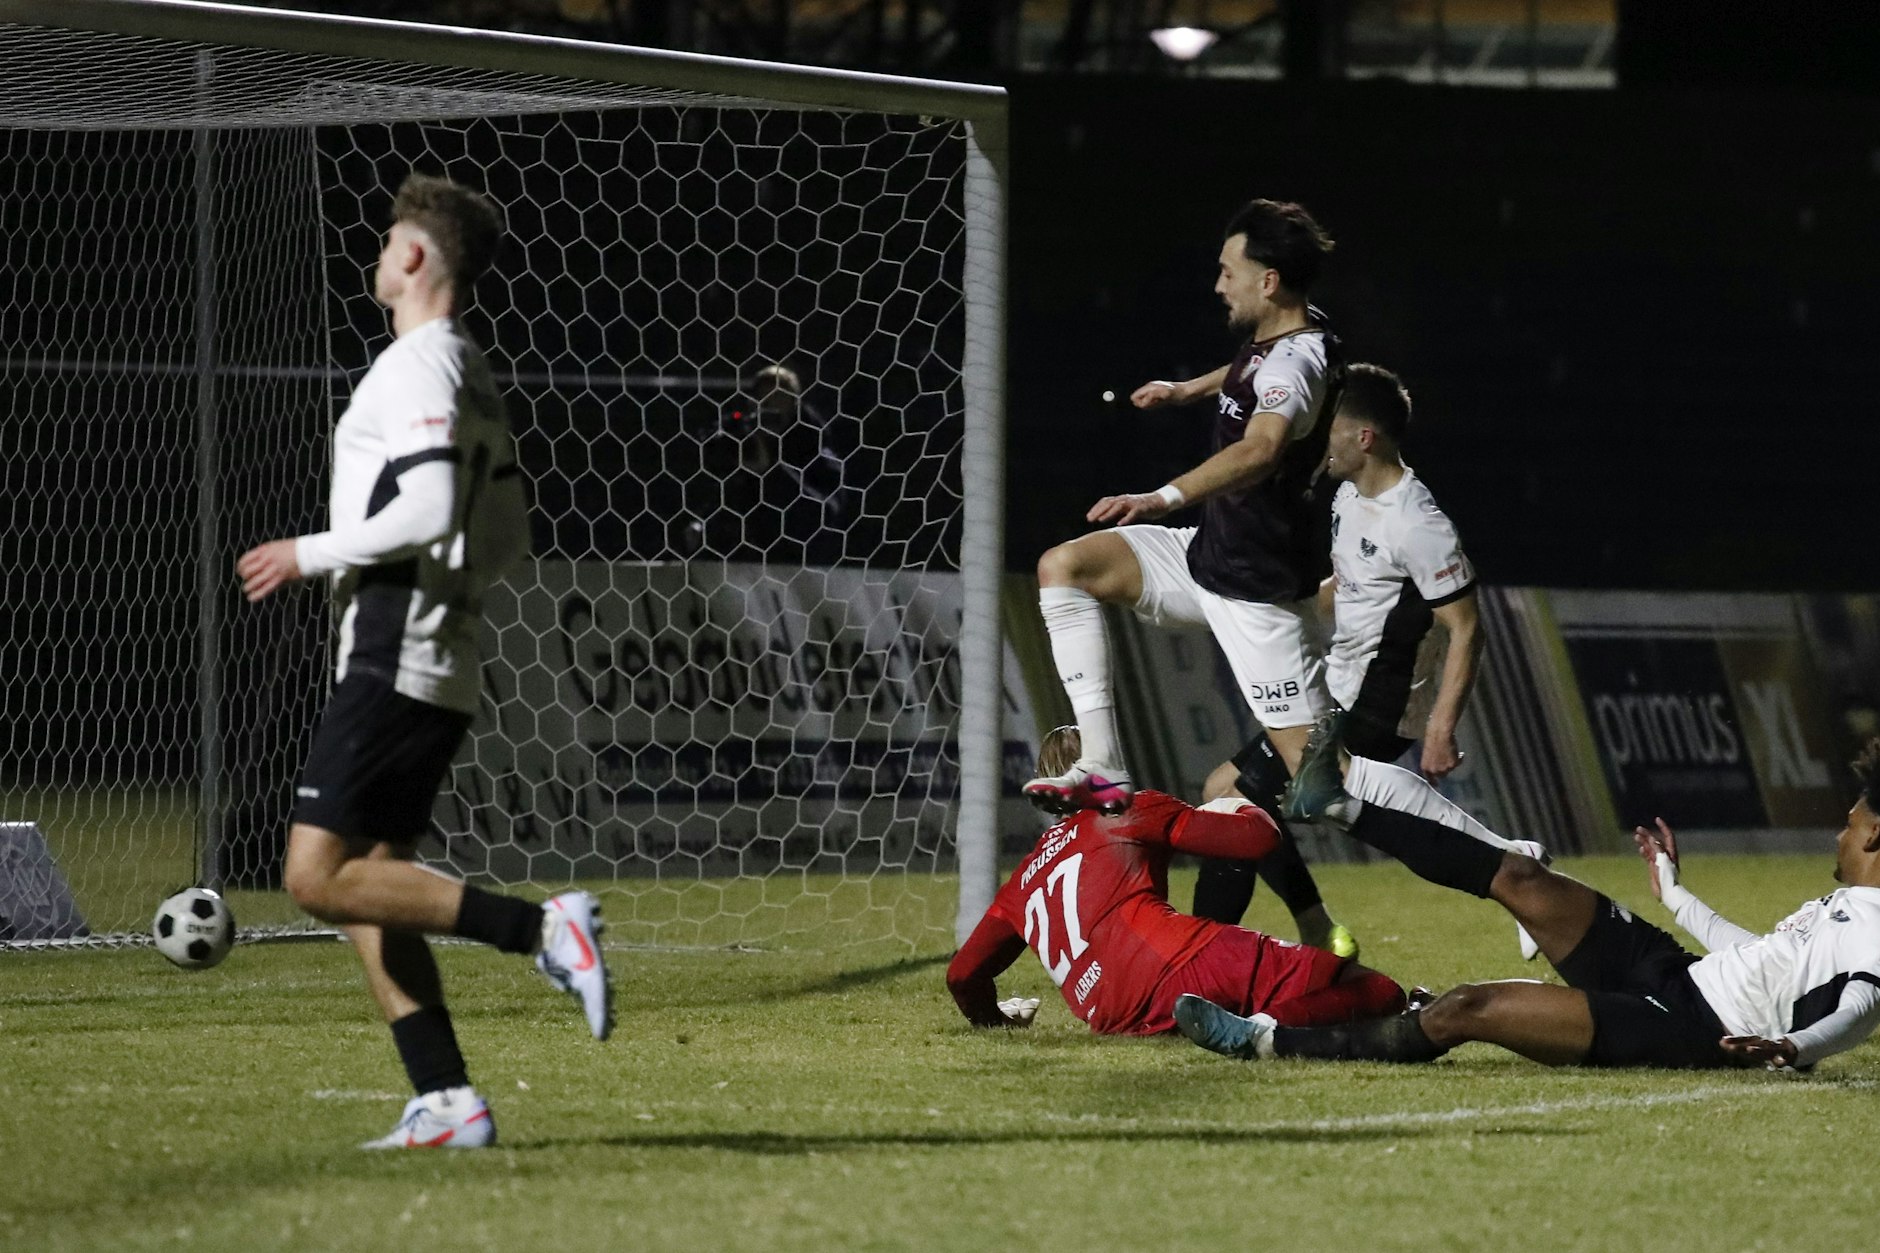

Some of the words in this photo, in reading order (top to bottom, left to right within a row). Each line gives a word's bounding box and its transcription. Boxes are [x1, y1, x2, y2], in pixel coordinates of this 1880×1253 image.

[1264, 704, 1290, 713] JAKO
[1595, 672, 1739, 792] primus
[1742, 680, 1832, 788] XL
[1020, 823, 1079, 890] PREUSSEN
[1024, 852, 1090, 988] 27
[1074, 960, 1102, 1005] ALBERS
